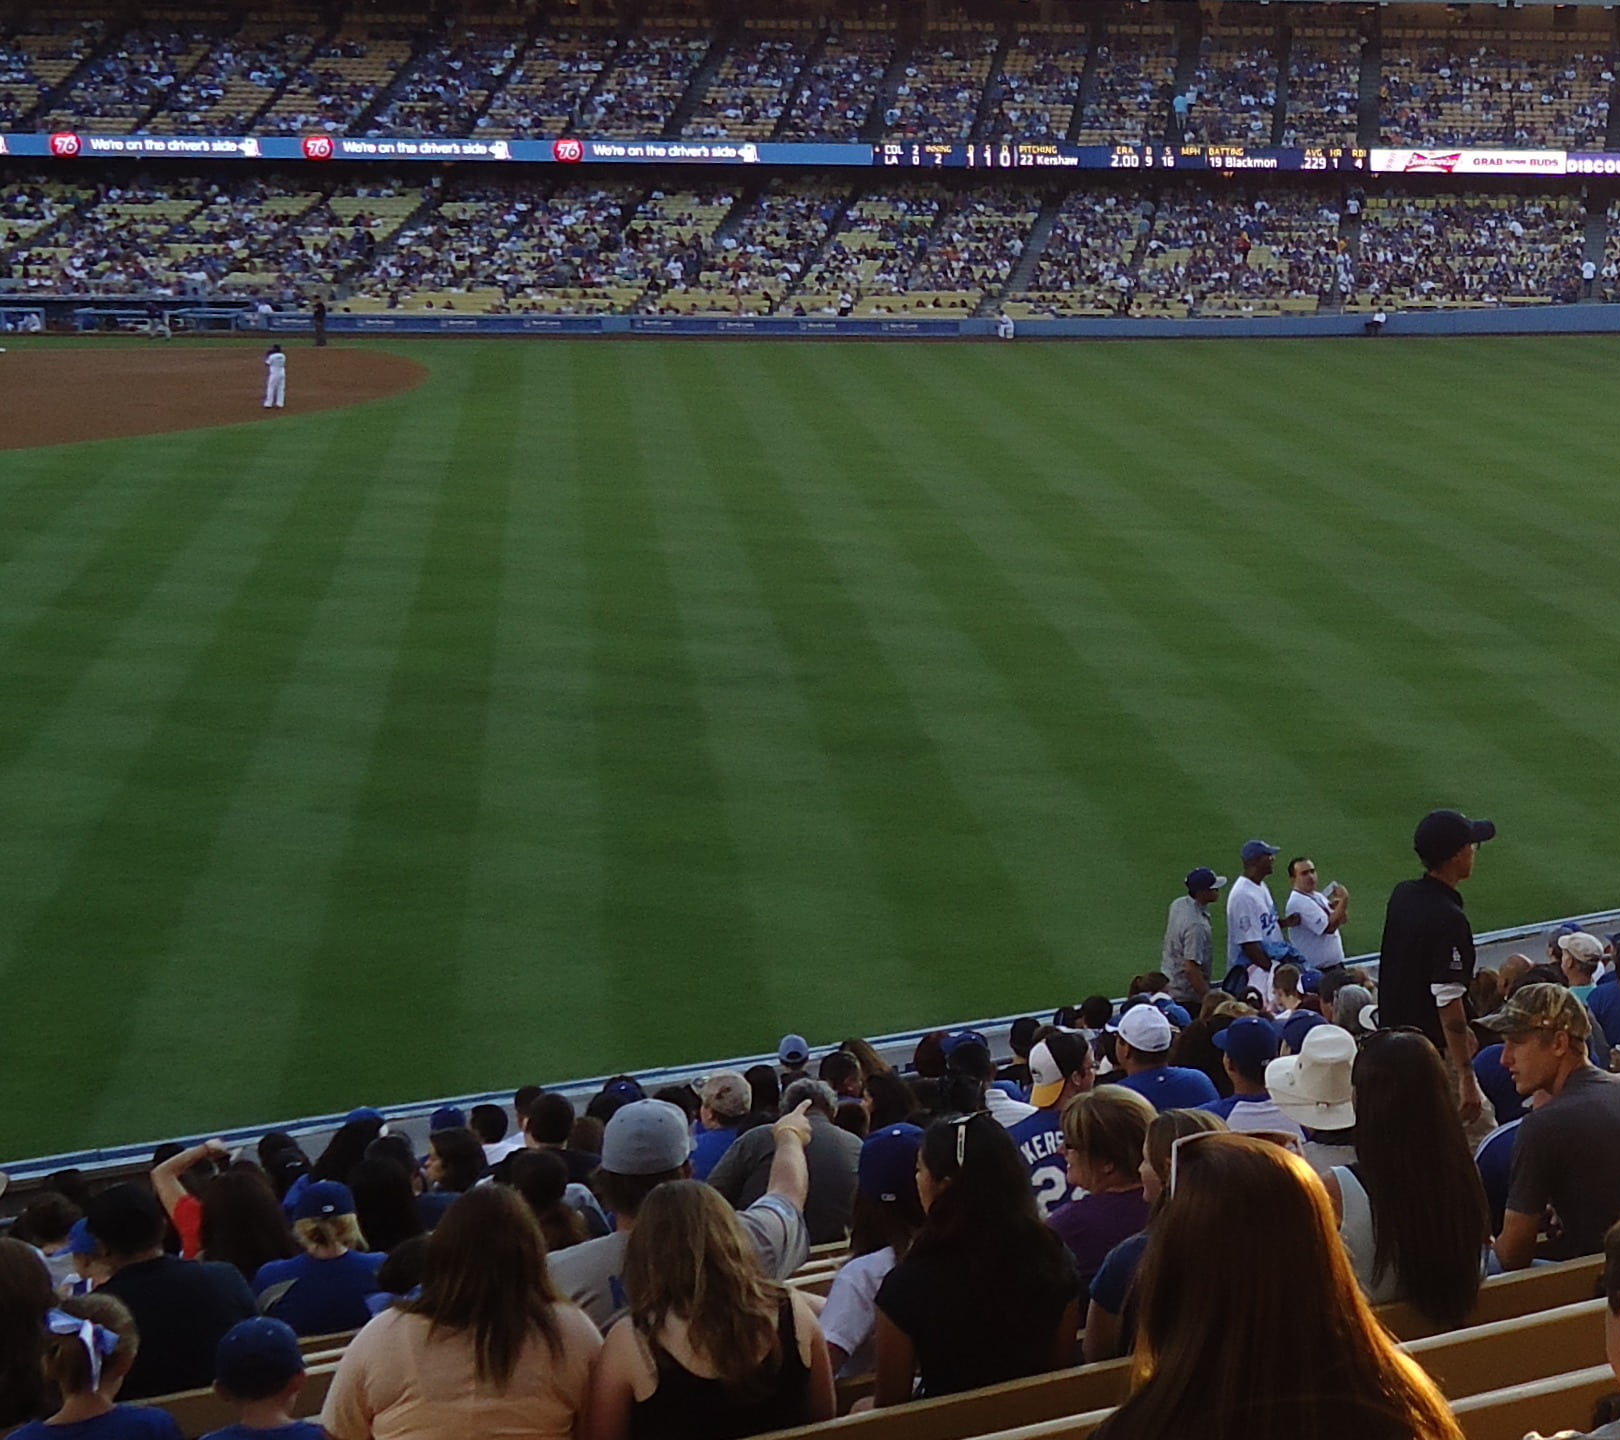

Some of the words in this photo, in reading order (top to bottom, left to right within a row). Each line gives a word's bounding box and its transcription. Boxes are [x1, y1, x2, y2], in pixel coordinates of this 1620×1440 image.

[55, 137, 79, 155] 76
[90, 138, 123, 151] We're
[126, 141, 143, 151] on
[144, 139, 166, 151] the
[167, 138, 210, 152] driver's
[211, 139, 238, 152] side
[306, 138, 331, 156] 76
[342, 140, 377, 153] We're
[379, 143, 396, 153] on
[397, 142, 417, 153] the
[420, 142, 460, 155] driver's
[462, 143, 487, 155] side
[557, 142, 580, 160] 76
[884, 145, 904, 155] COL
[912, 145, 919, 155] 2
[1019, 145, 1058, 155] PITCHING
[1116, 146, 1134, 156] ERA
[1165, 146, 1171, 156] S
[1181, 147, 1200, 156] MPH
[592, 144, 627, 157] We're
[628, 147, 644, 157] on
[646, 145, 666, 158] the
[668, 145, 710, 159] driver's
[711, 146, 737, 159] side
[1208, 147, 1244, 157] BATTING
[1305, 148, 1323, 158] AVG
[1330, 148, 1342, 158] HR
[1352, 149, 1367, 158] RBI
[884, 155, 899, 165] LA
[912, 155, 919, 165] 0
[934, 154, 942, 164] 2
[967, 154, 974, 167] 1
[984, 154, 992, 167] 1
[1000, 154, 1010, 167] 0
[1019, 155, 1033, 166] 22
[1036, 155, 1078, 166] Kershaw
[1110, 155, 1139, 168] 2.00
[1144, 156, 1153, 168] 9
[1161, 156, 1175, 168] 16
[1208, 157, 1222, 168] 19
[1225, 157, 1277, 169] Blackmon
[1300, 157, 1327, 170] .229
[1332, 158, 1339, 169] 1
[1354, 159, 1363, 170] 4
[1473, 158, 1502, 166] GRAB
[1530, 159, 1559, 167] BUDS
